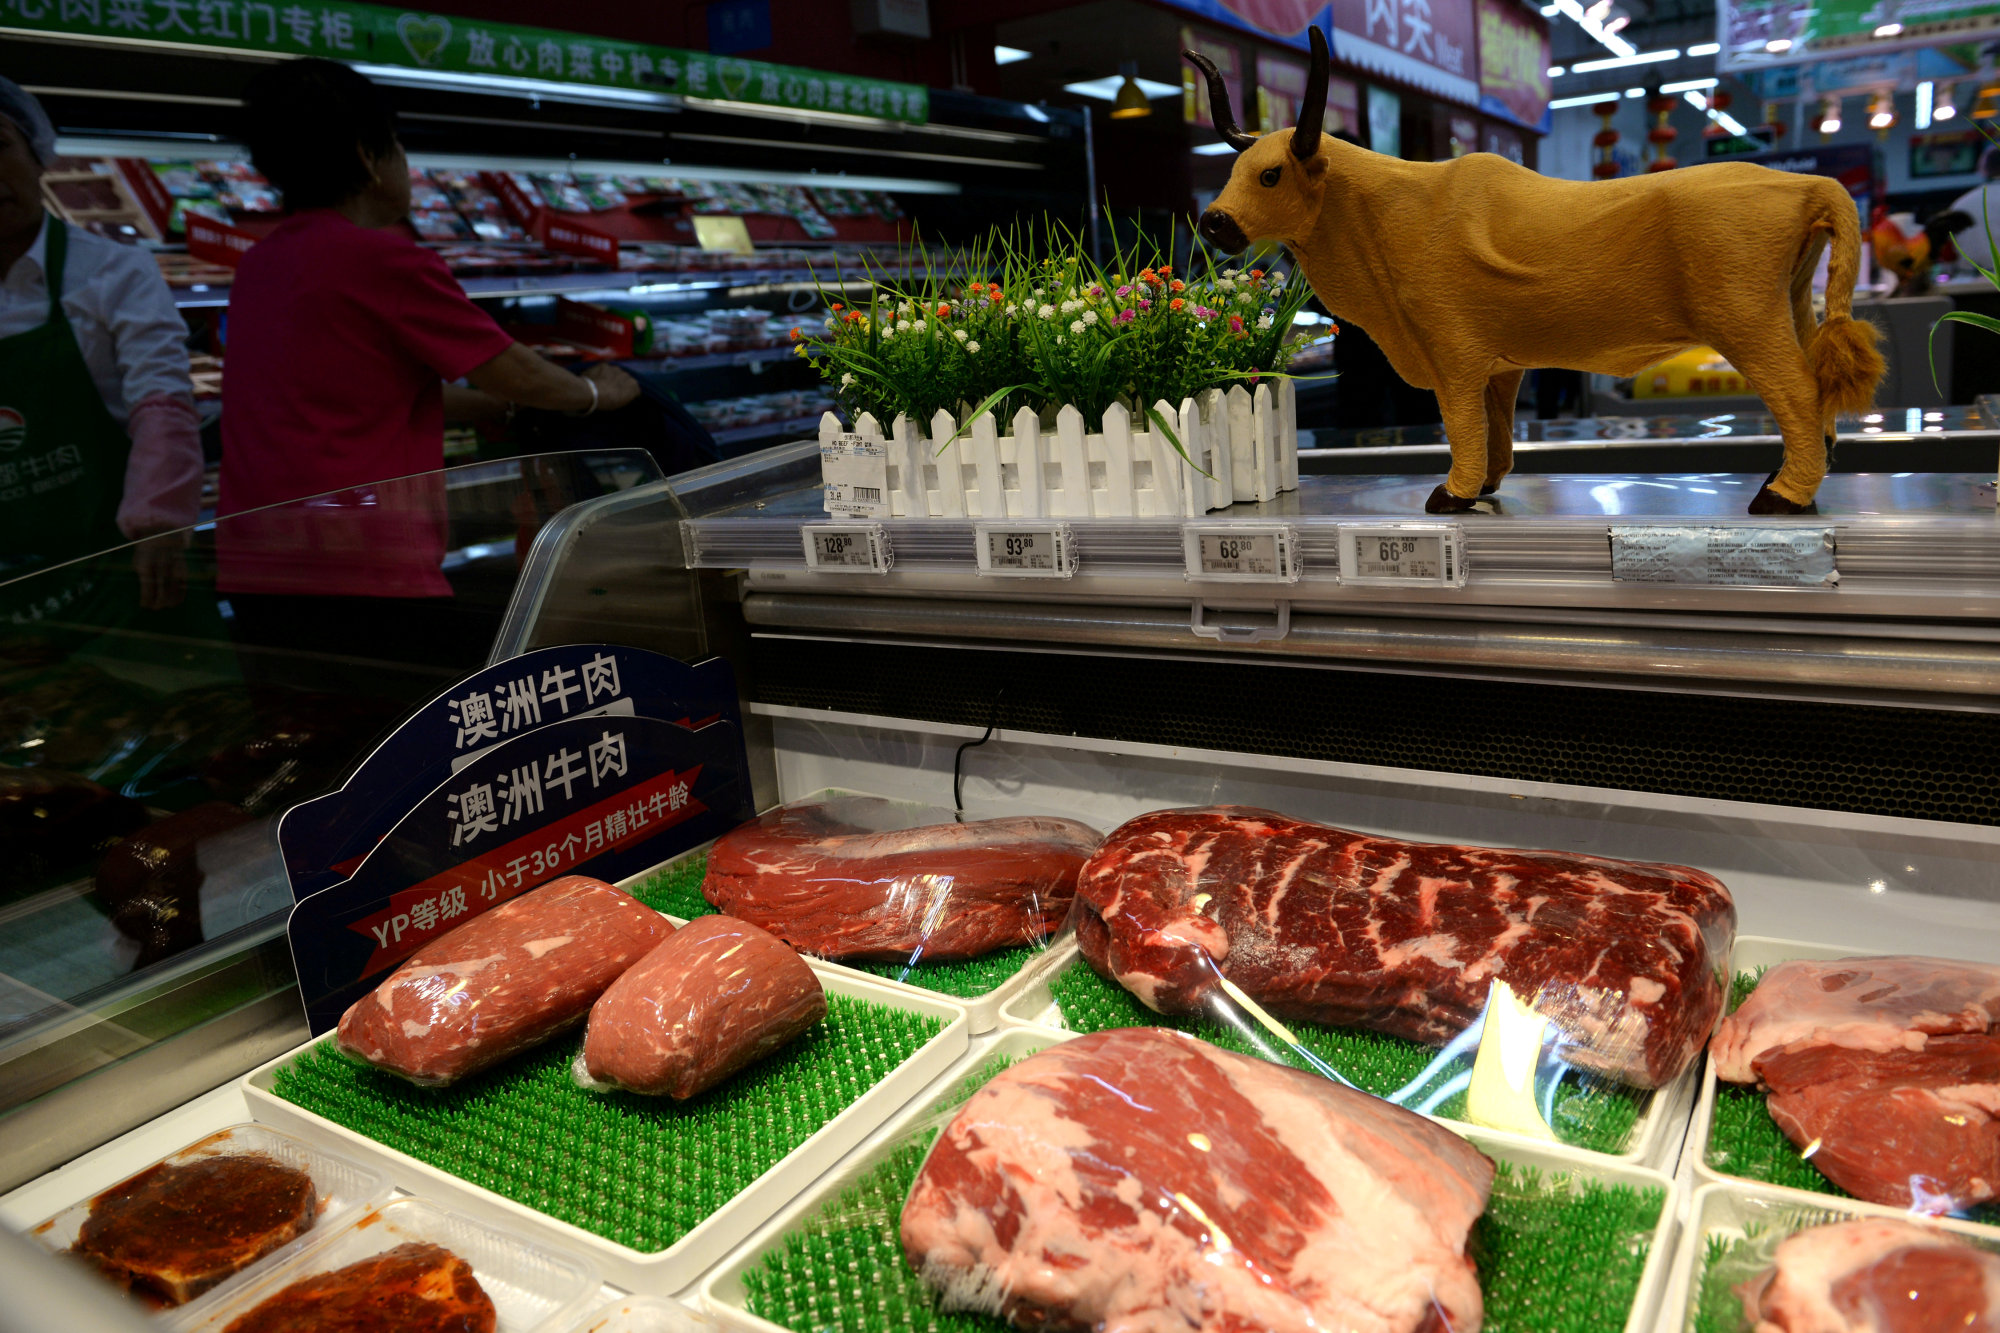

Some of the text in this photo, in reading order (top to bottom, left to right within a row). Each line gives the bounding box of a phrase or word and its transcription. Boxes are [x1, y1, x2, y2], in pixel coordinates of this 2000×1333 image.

[0, 0, 356, 51] 心肉菜大红门专柜
[1006, 538, 1034, 555] 93.80
[1220, 540, 1252, 559] 68.80
[1380, 541, 1415, 561] 66.80
[447, 652, 622, 749] 澳洲牛肉
[446, 731, 629, 847] 澳洲牛肉
[371, 780, 690, 950] YP等级 小于36个月精壮牛龄
